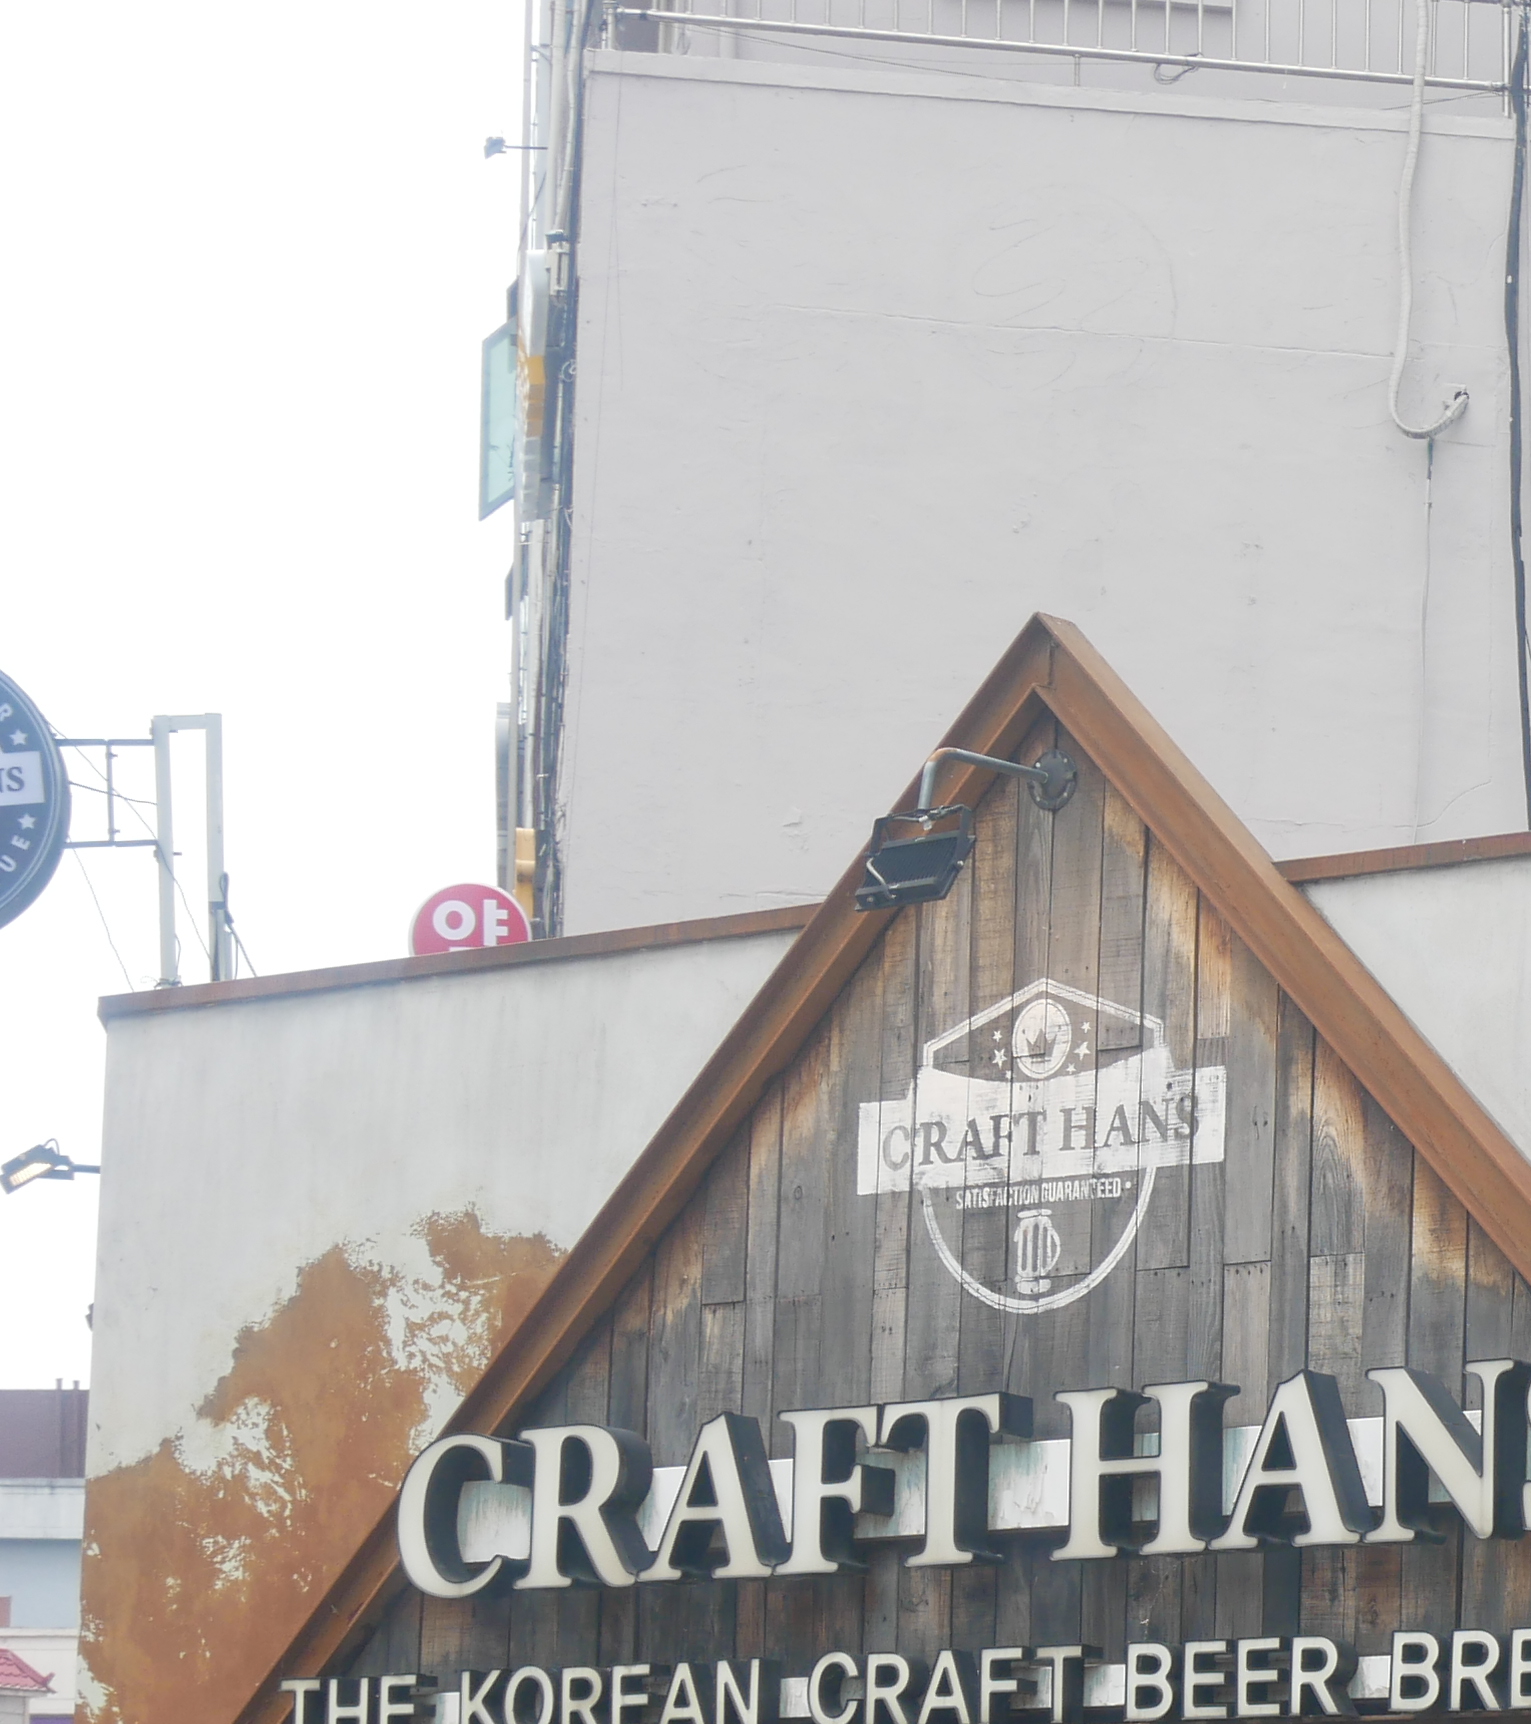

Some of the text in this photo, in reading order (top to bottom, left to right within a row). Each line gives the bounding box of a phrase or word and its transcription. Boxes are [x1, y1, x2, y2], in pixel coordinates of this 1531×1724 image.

[883, 1092, 1200, 1172] CRAFT HANS
[956, 1177, 1121, 1210] SATISFACTION GUARANTEED
[400, 1392, 1003, 1600] CRAFT
[1125, 1635, 1345, 1723] BEER
